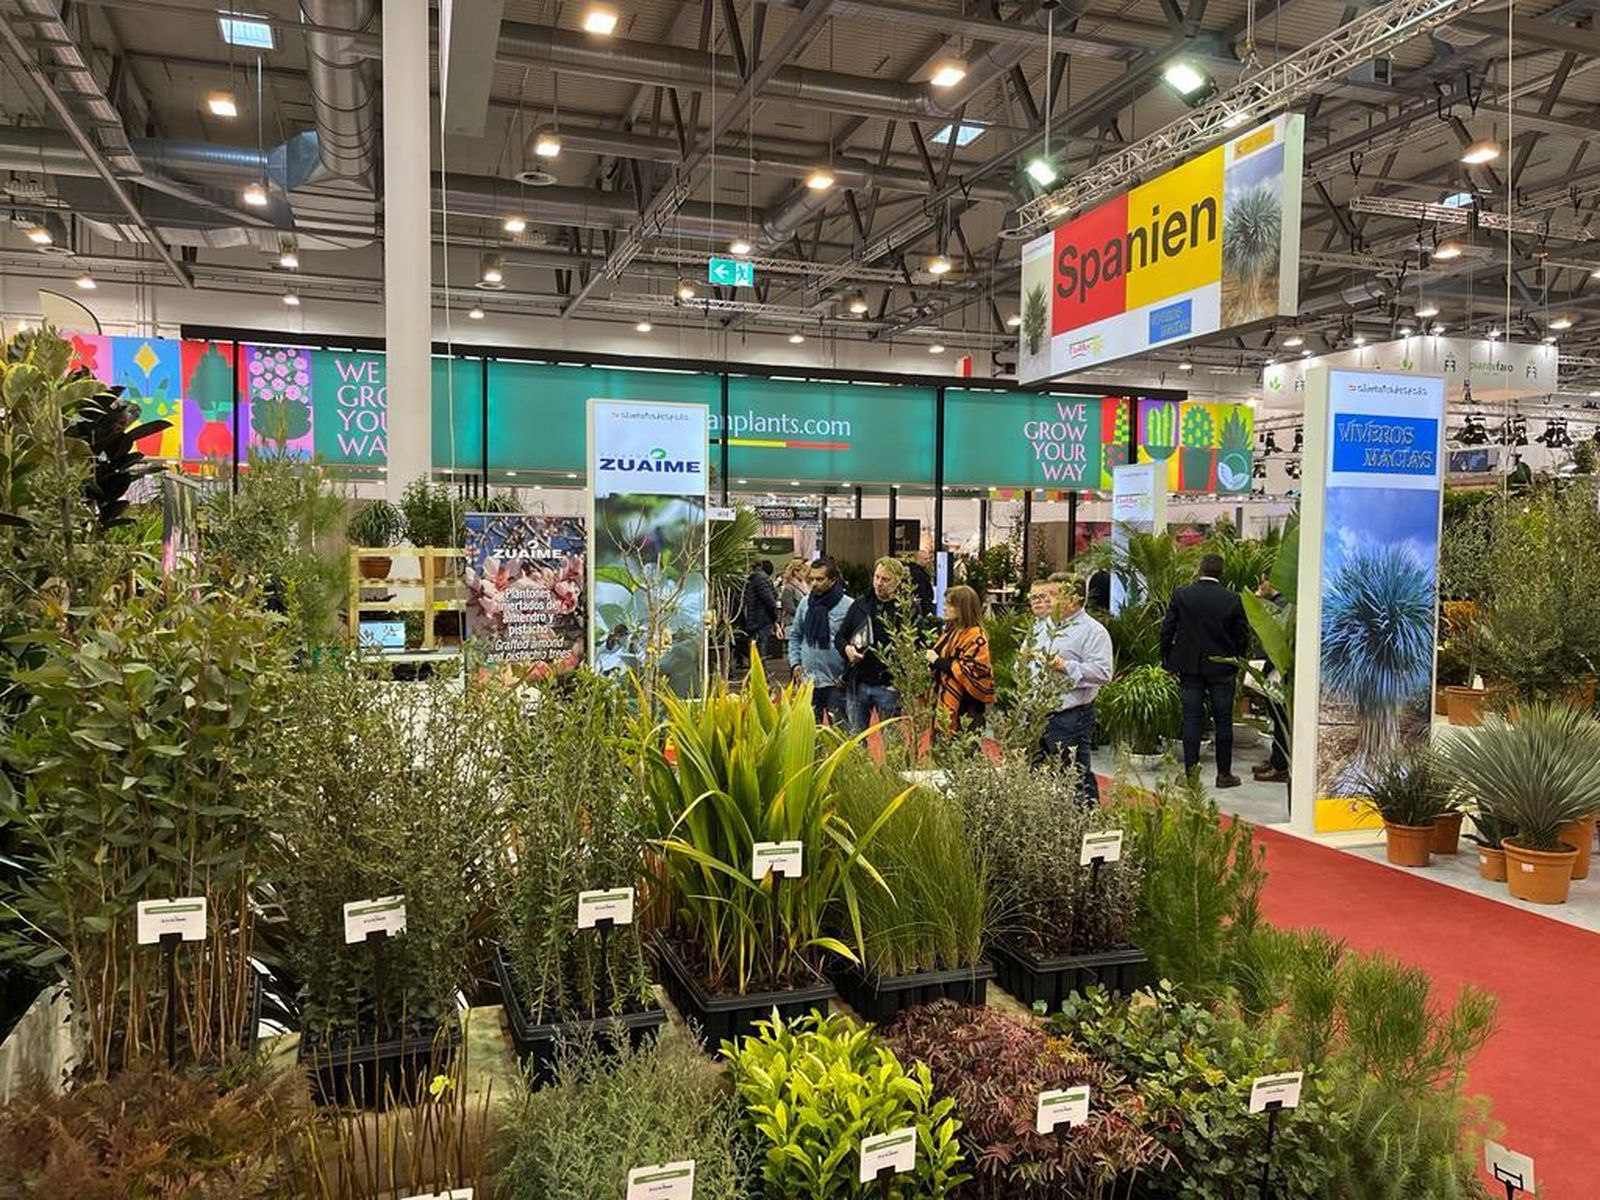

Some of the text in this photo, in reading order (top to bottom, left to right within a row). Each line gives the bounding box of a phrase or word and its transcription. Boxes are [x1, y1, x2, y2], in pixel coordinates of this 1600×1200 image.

[1056, 195, 1218, 303] Spanien
[334, 359, 381, 384] WE
[1056, 401, 1087, 422] WE
[1024, 421, 1088, 441] GROW
[1031, 442, 1088, 461] YOUR
[599, 458, 701, 473] ZUAIME
[1041, 462, 1087, 482] WAY
[493, 548, 563, 559] ZUAIME
[504, 588, 551, 600] Plantones
[546, 599, 558, 610] de
[547, 614, 555, 625] y
[508, 624, 548, 637] pistacho
[495, 638, 529, 651] Grafted
